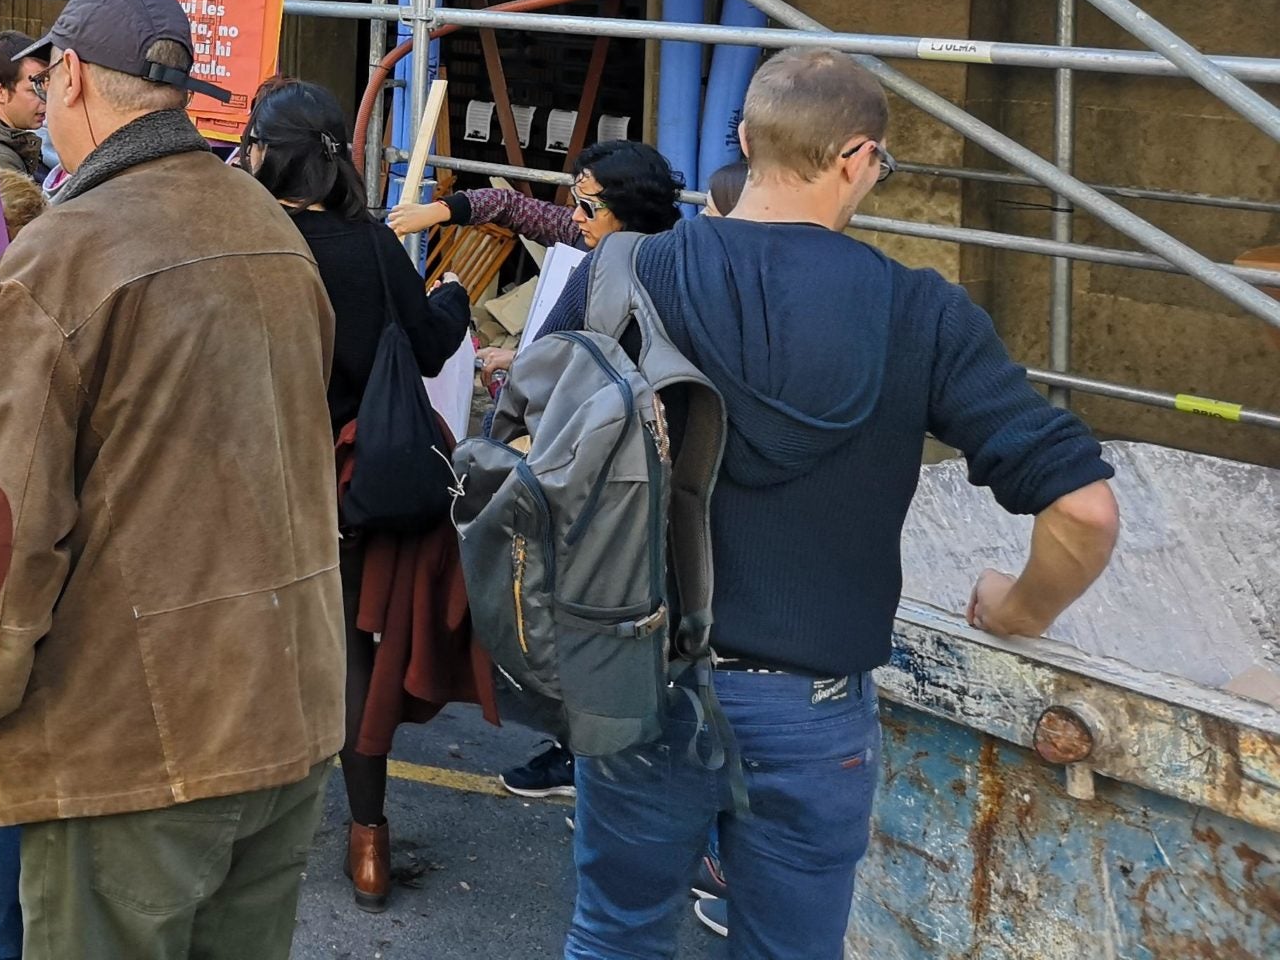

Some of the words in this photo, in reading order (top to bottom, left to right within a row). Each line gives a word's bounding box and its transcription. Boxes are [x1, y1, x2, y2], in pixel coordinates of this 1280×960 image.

[180, 0, 197, 14] ui
[202, 0, 225, 16] les
[218, 25, 239, 37] no
[193, 40, 210, 54] ui
[215, 40, 232, 57] hi
